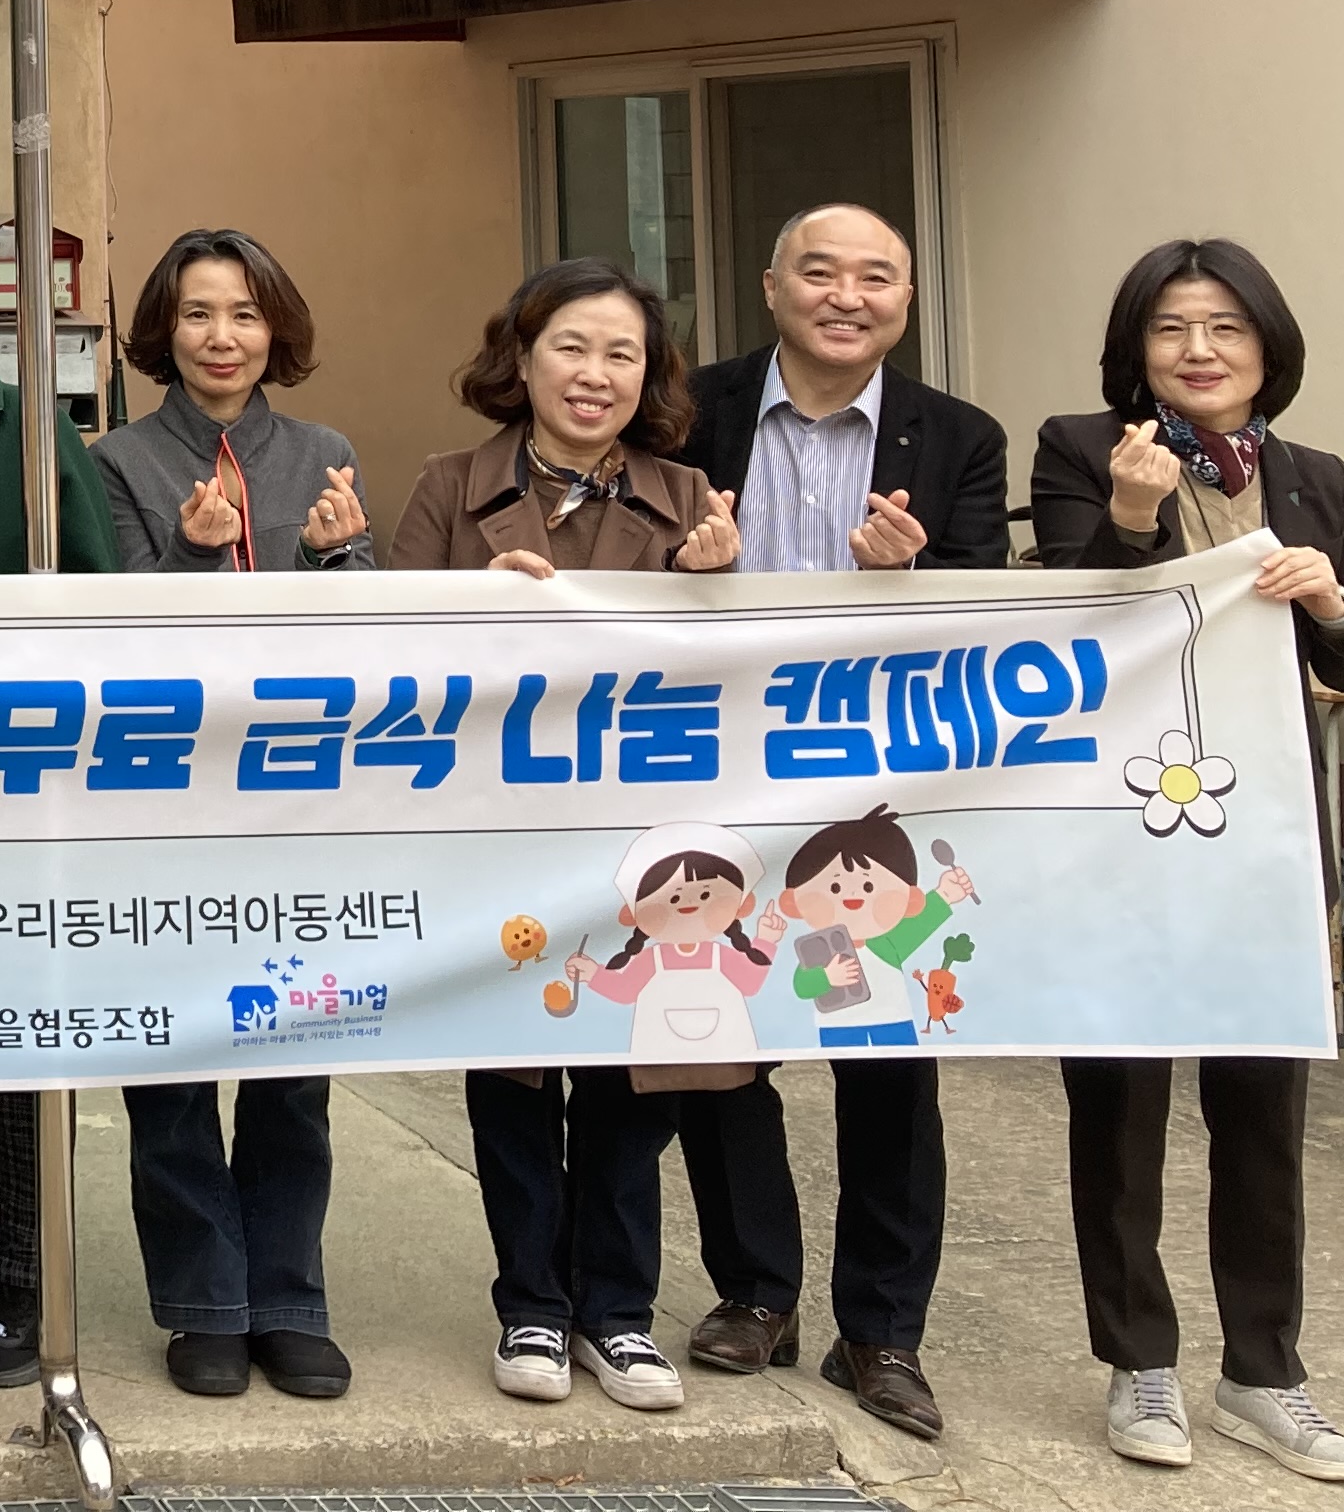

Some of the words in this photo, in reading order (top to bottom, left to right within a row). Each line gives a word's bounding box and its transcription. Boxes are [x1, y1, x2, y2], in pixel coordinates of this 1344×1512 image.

[237, 675, 472, 791] 급식
[501, 671, 722, 784] 나눔
[763, 639, 1108, 779] 캠페인
[289, 973, 388, 1016] 마을기업
[290, 1017, 342, 1029] Community
[344, 1015, 383, 1025] Business
